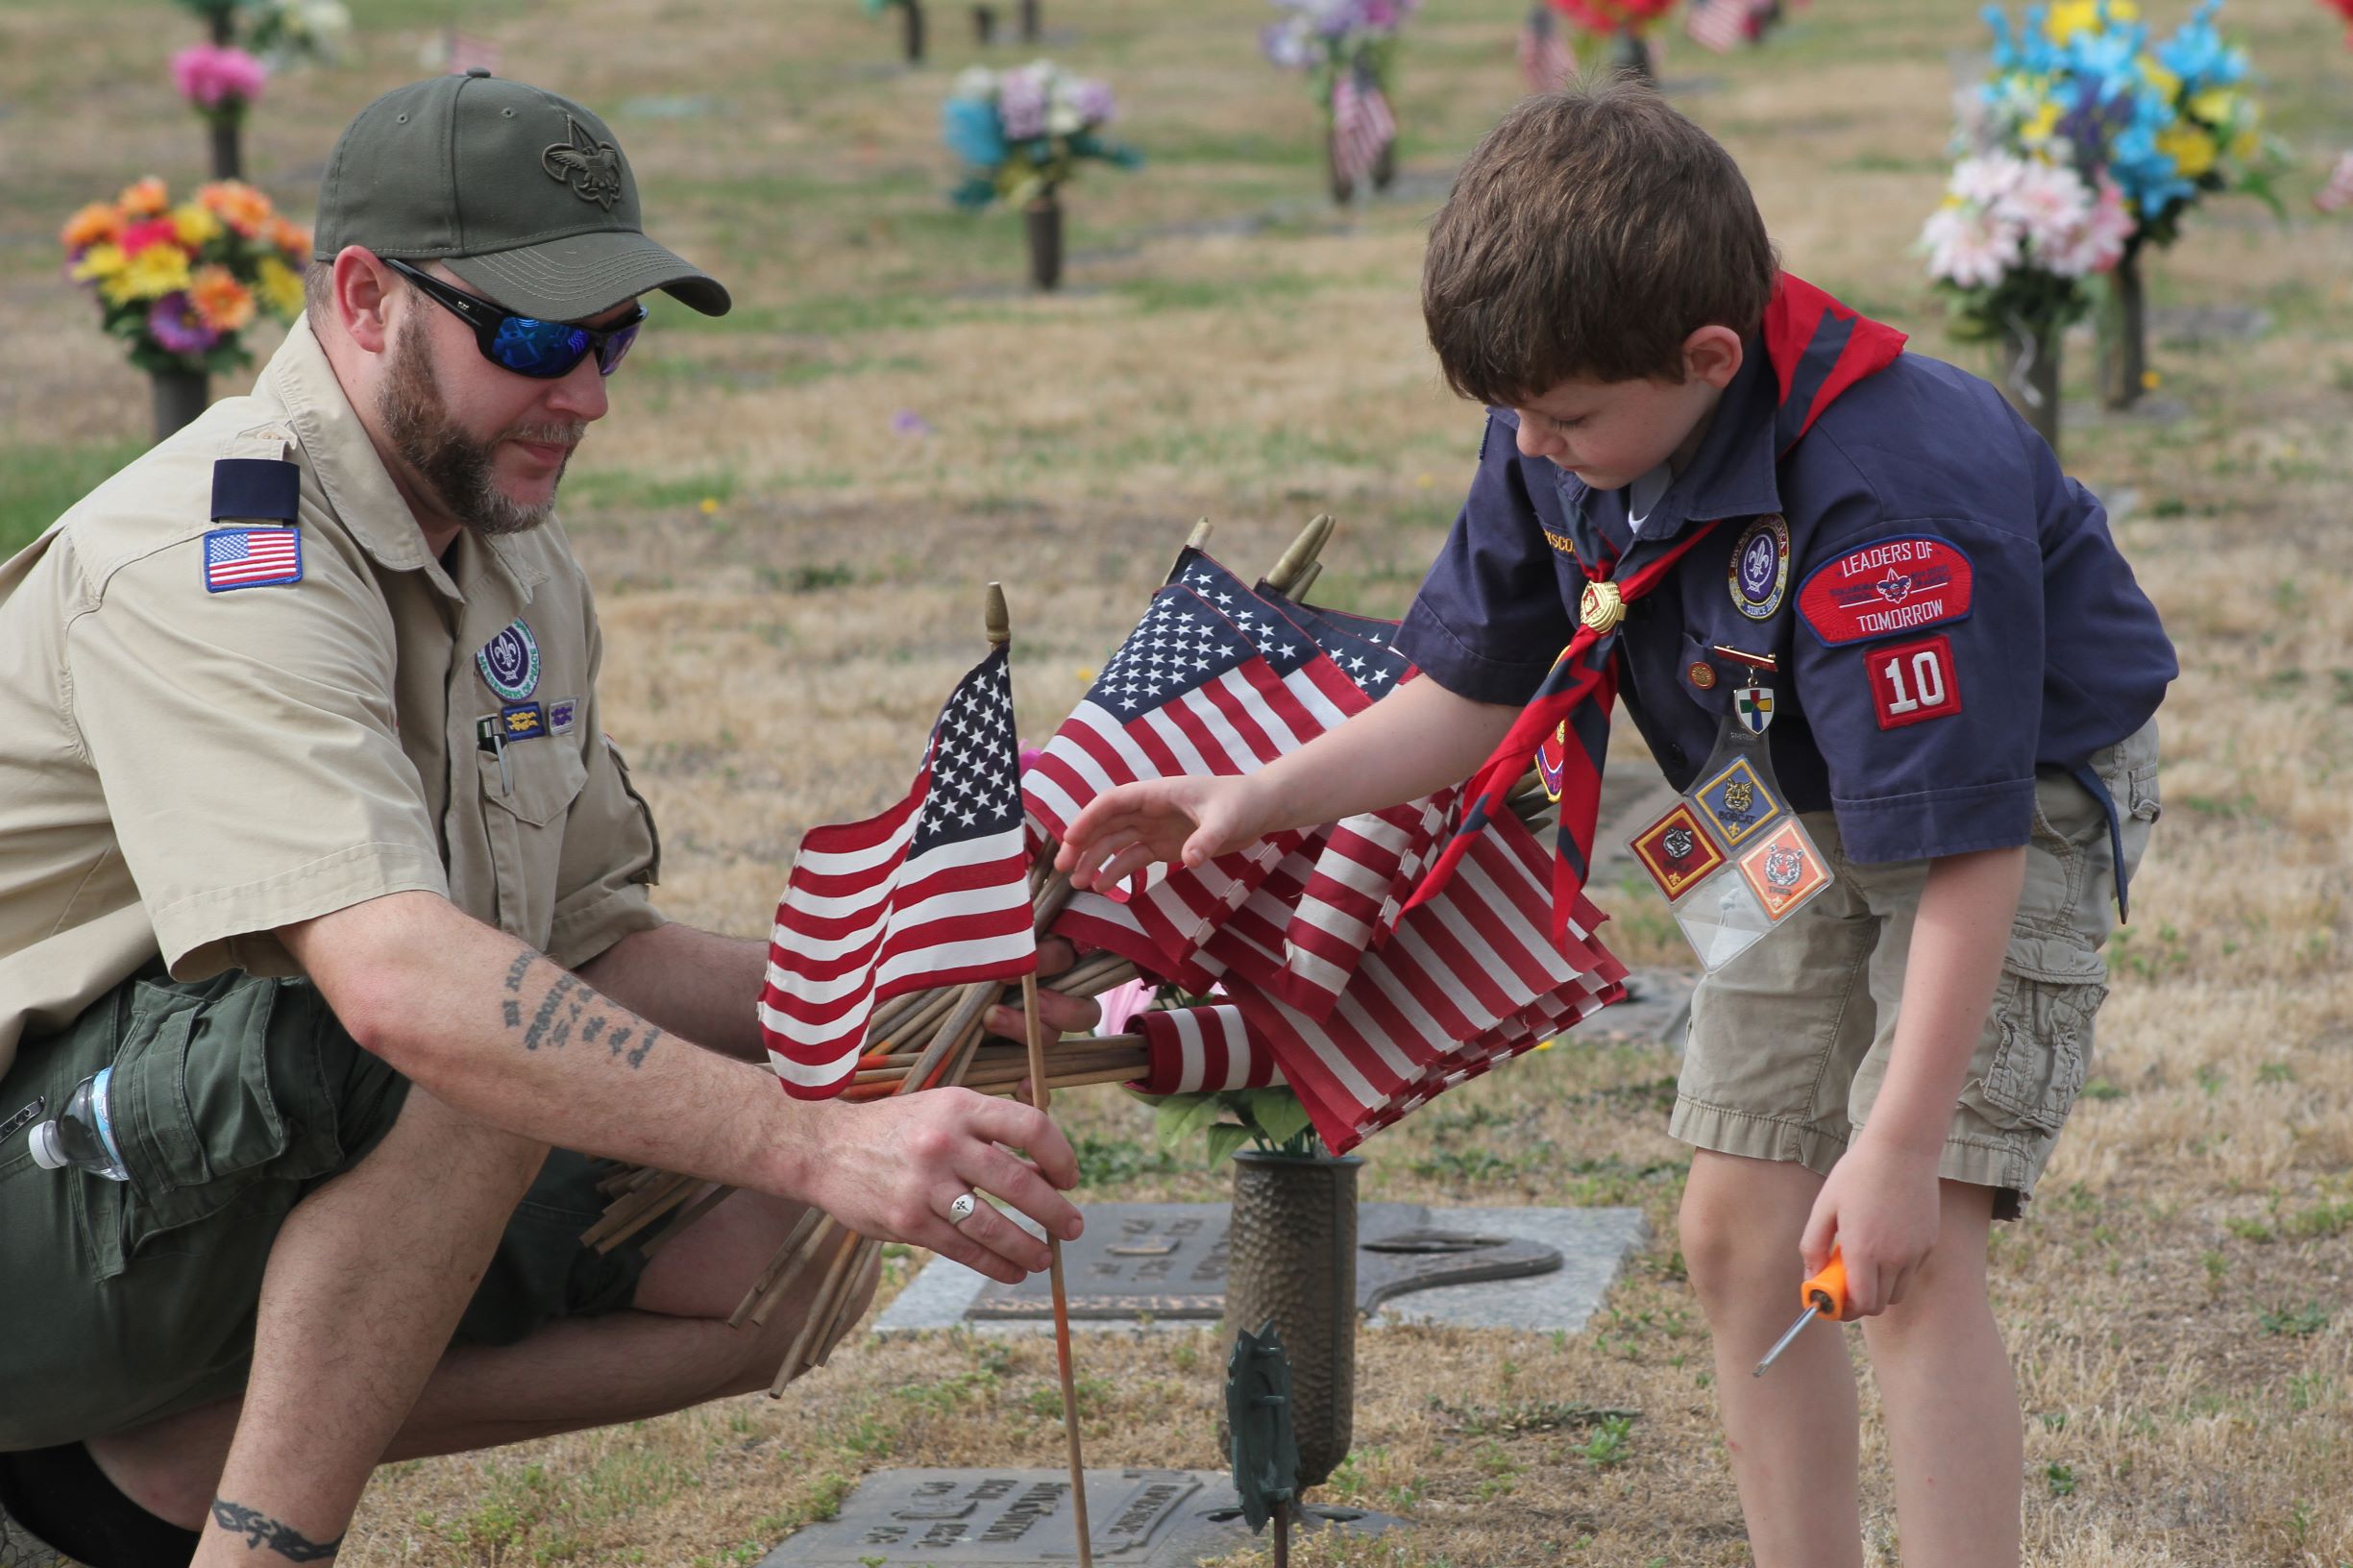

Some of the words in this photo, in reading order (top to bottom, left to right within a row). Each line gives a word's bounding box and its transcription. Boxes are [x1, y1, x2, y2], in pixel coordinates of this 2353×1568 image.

[1842, 543, 1911, 578] LEADERS
[1915, 541, 1933, 560] OF
[1856, 599, 1943, 633] TOMORROW
[1884, 650, 1946, 715] 10
[1718, 810, 1755, 824] BOBCAT
